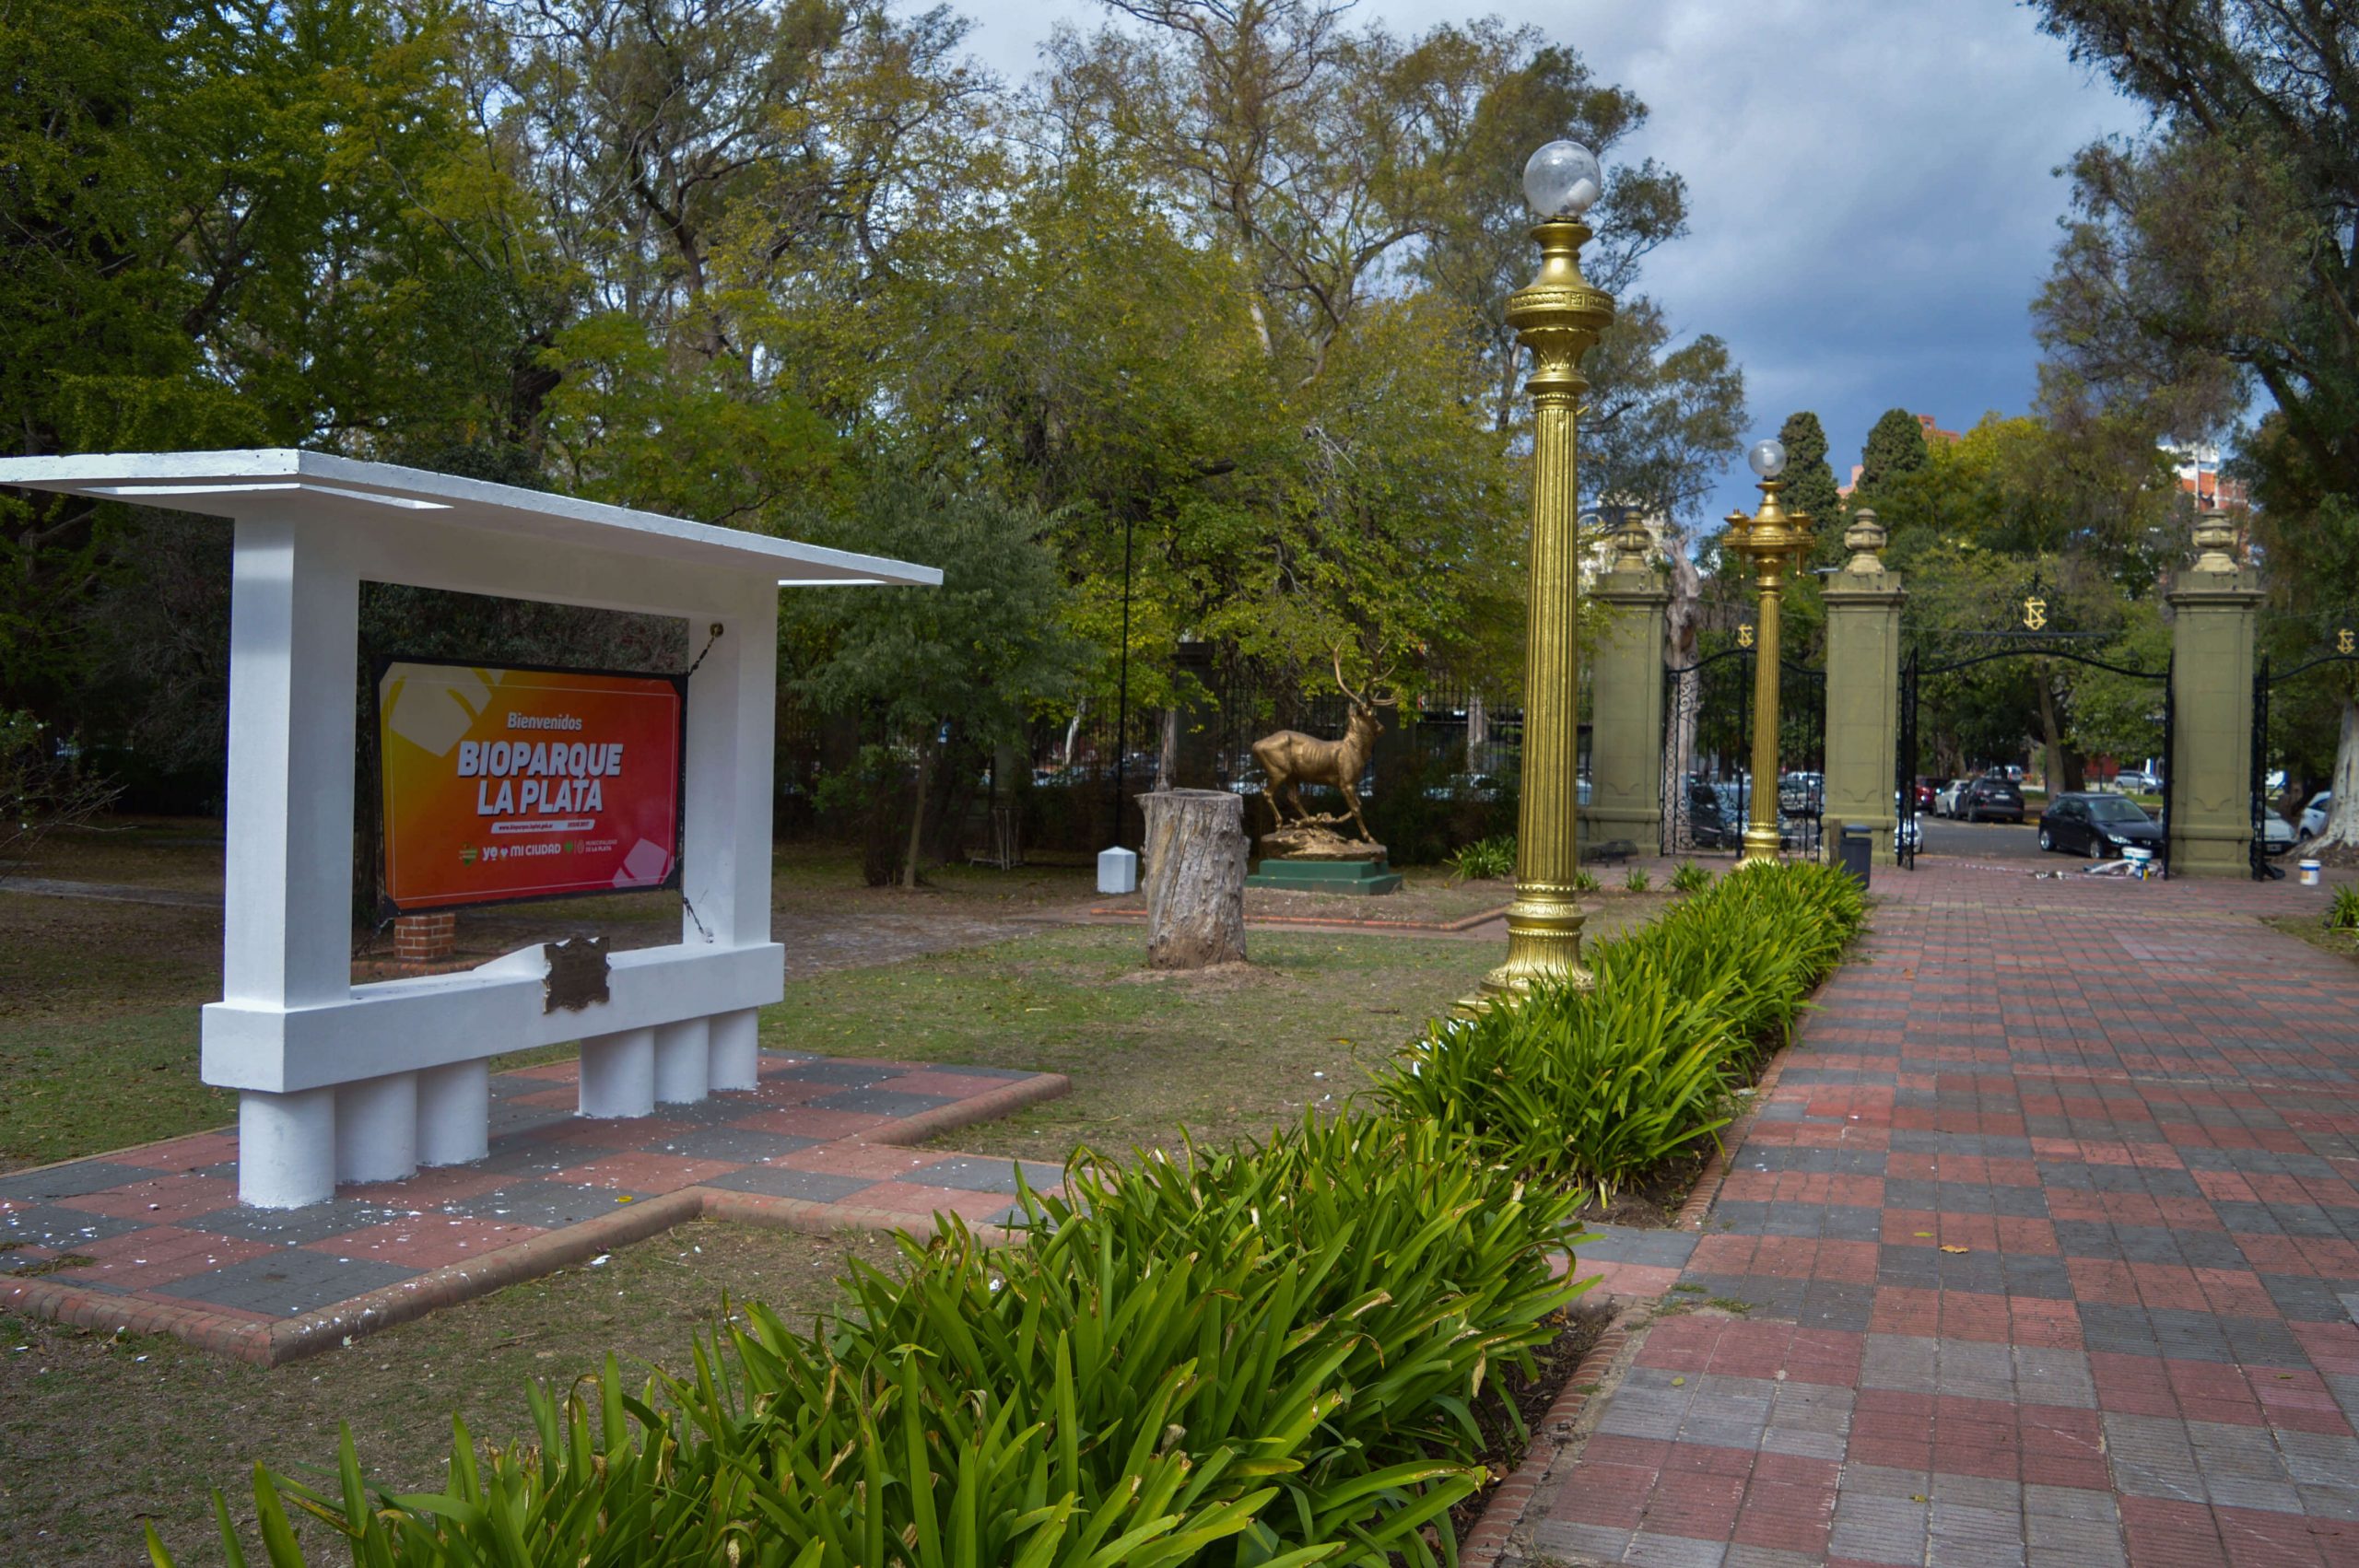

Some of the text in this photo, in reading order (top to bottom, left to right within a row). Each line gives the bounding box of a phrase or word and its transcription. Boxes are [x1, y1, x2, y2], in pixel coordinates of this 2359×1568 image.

[507, 711, 582, 731] Bienvenidos
[457, 741, 624, 779] BIOPARQUE
[477, 778, 604, 815] LA PLATA
[525, 843, 561, 857] CIUDAD
